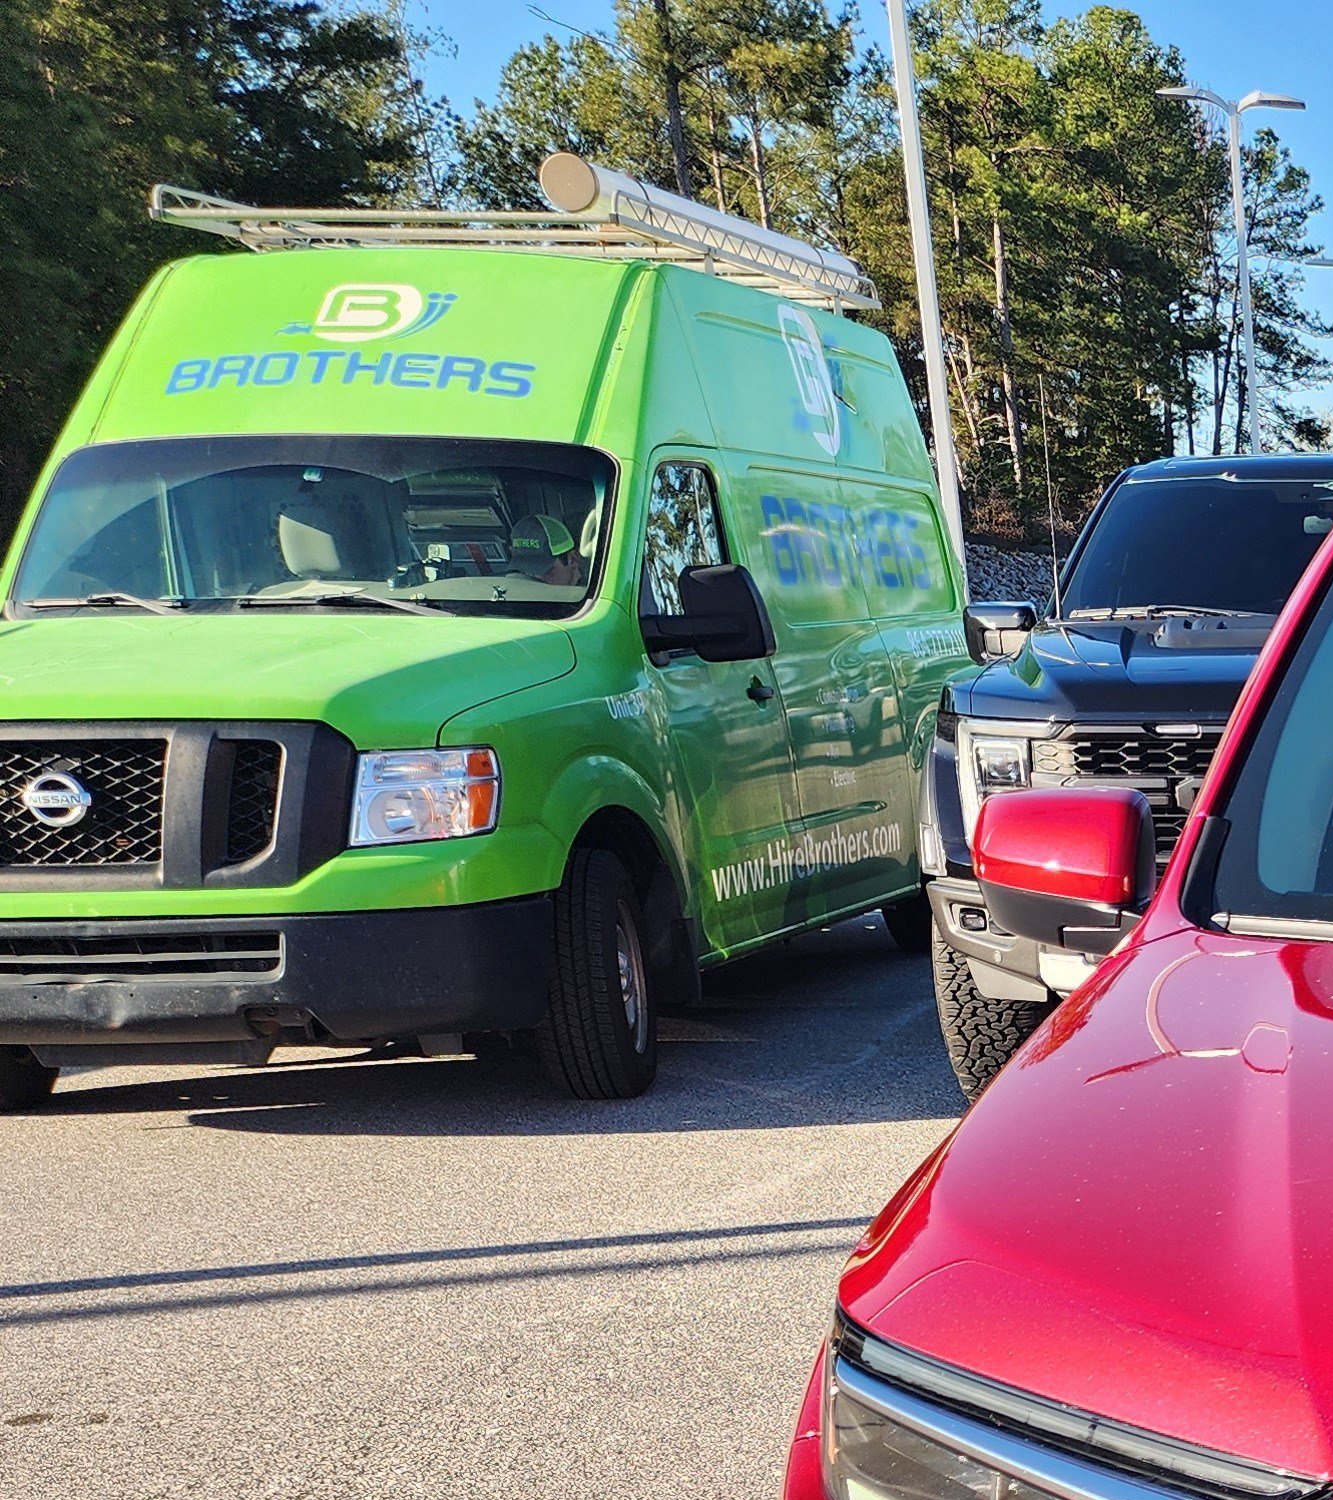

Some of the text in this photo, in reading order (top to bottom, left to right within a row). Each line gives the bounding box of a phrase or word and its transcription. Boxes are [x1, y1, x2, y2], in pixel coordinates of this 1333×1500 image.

[165, 351, 537, 398] BROTHERS
[604, 694, 633, 720] Unit
[28, 794, 82, 804] NISSAN
[711, 822, 901, 902] www.HireBrothers.com
